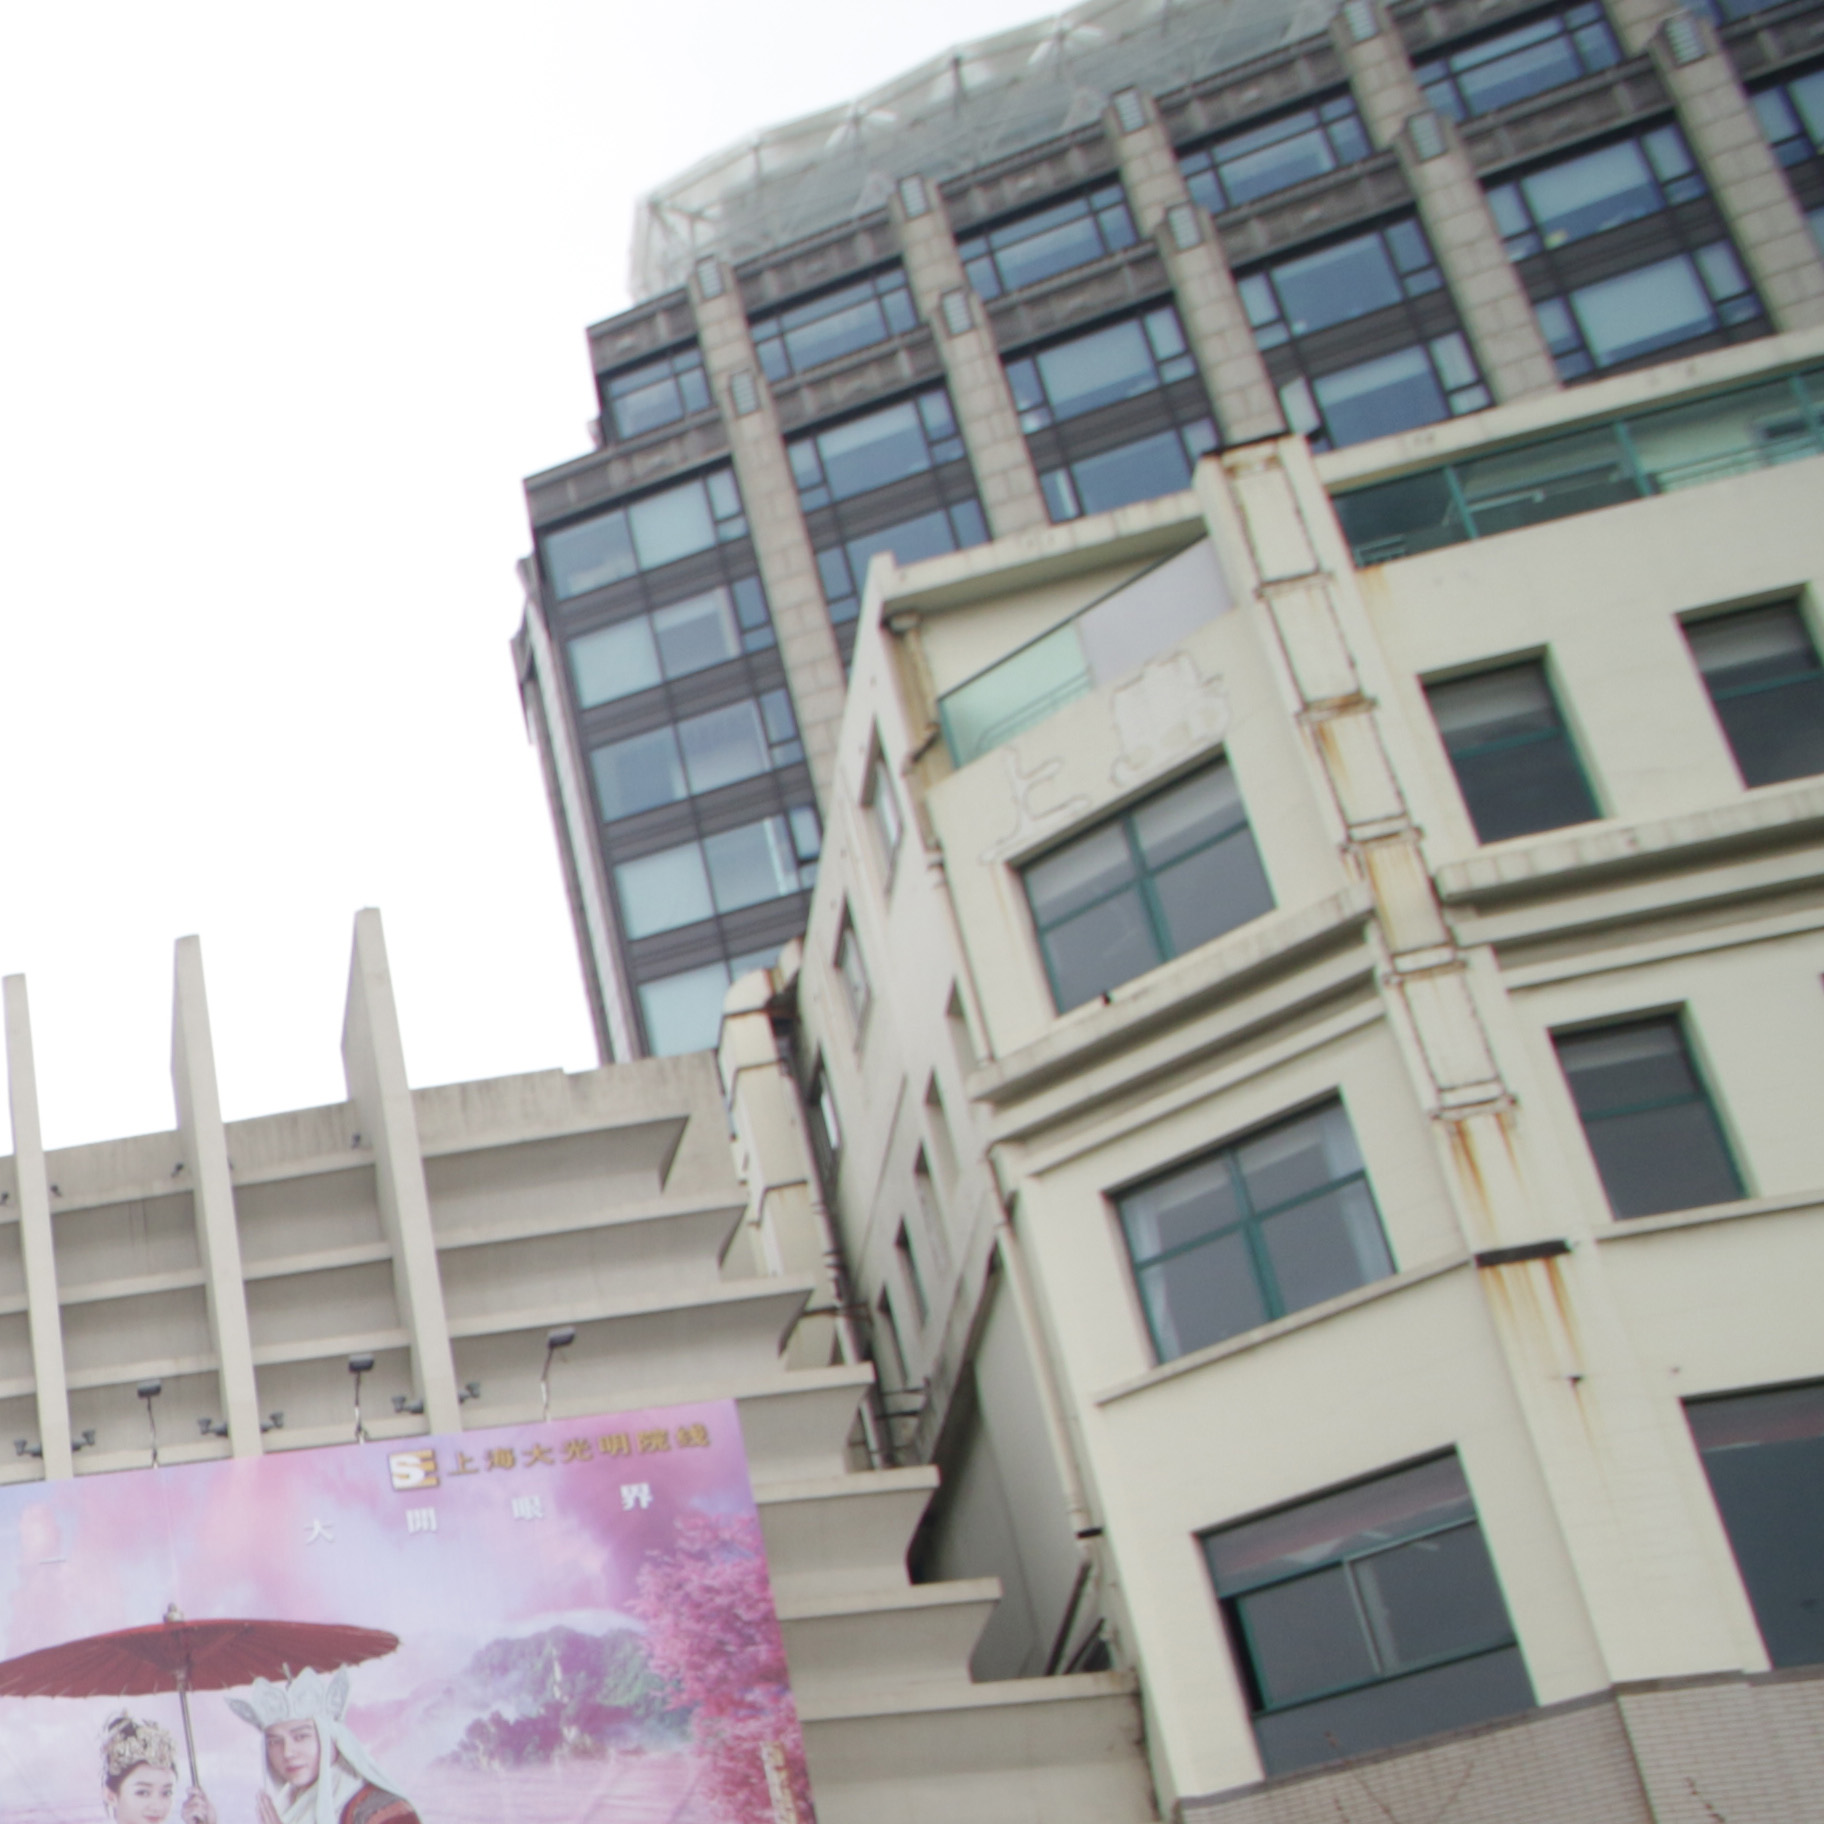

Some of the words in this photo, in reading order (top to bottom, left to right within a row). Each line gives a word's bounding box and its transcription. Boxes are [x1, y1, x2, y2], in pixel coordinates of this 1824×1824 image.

[447, 1423, 711, 1477] 上海大光明院线
[304, 1481, 654, 1545] 大開眼界
